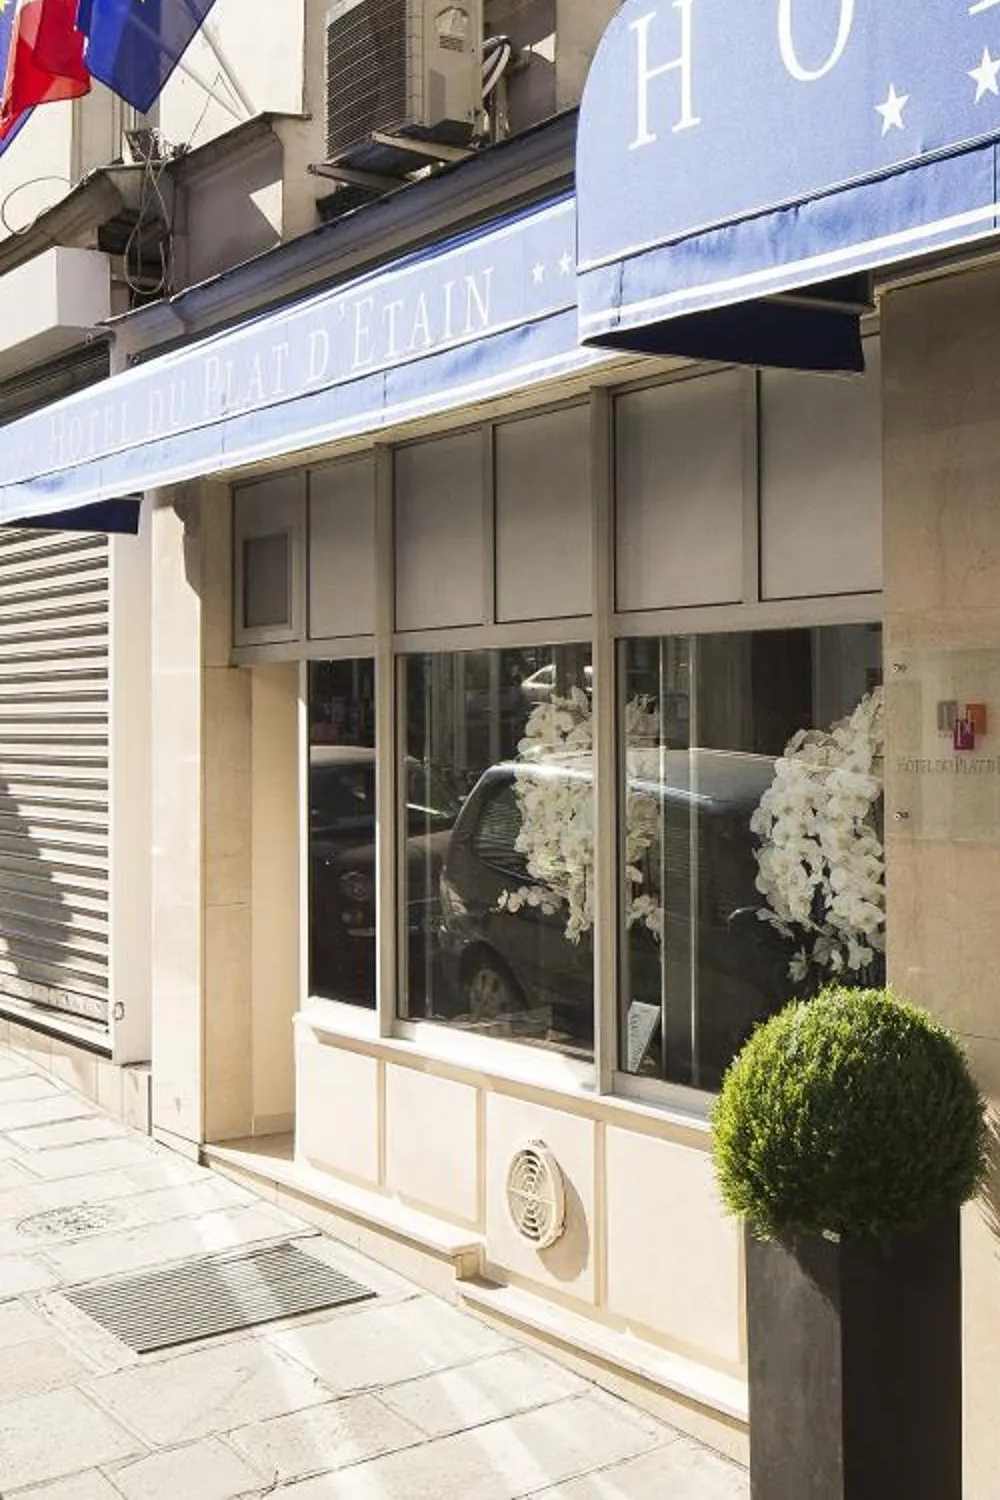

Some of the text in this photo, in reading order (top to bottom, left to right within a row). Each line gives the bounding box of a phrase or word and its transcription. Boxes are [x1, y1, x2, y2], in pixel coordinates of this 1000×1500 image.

[50, 400, 131, 462] HOTEL
[149, 379, 187, 434] DU
[203, 341, 290, 416] PLAT
